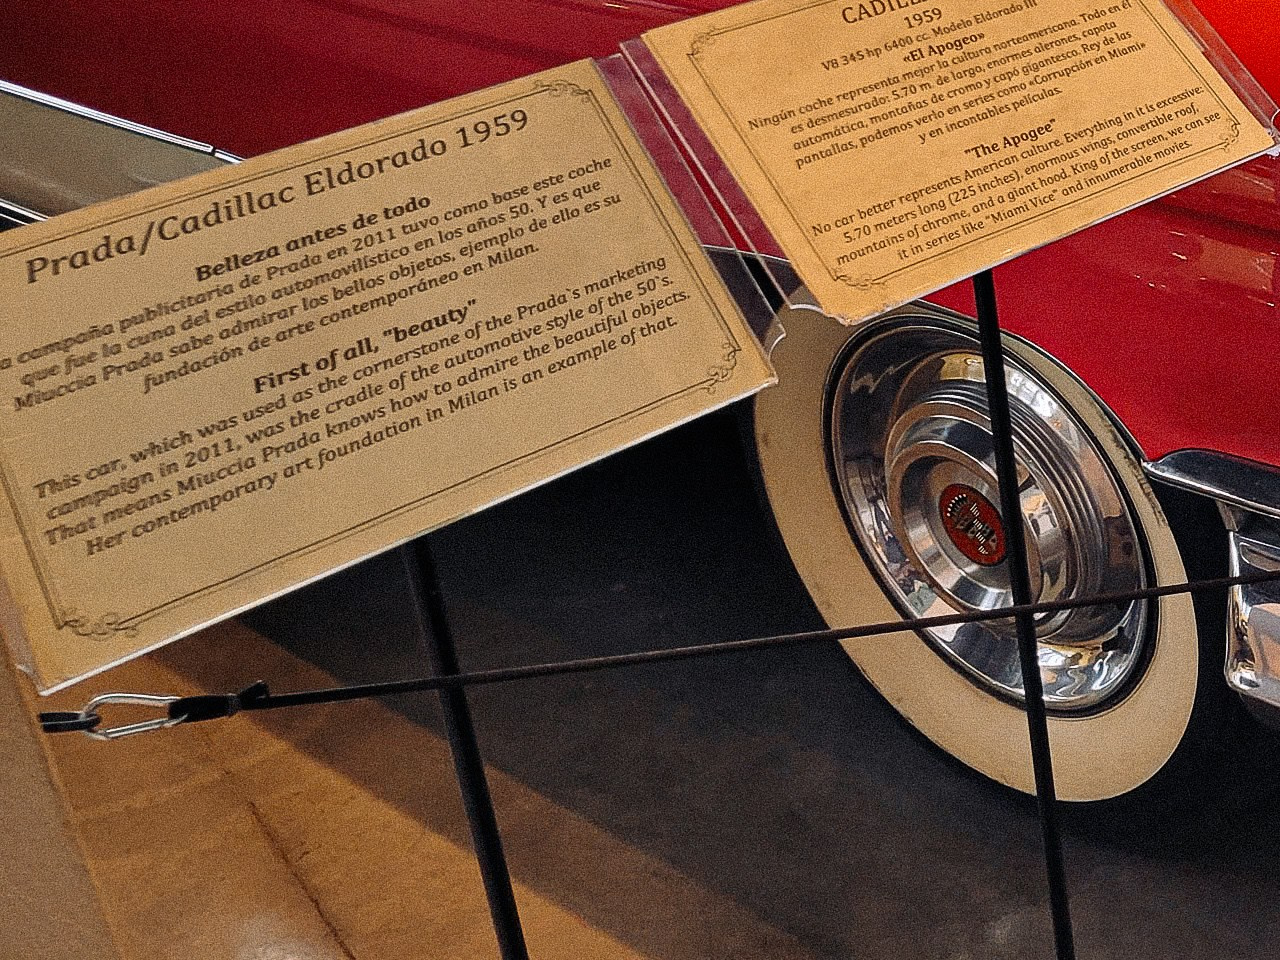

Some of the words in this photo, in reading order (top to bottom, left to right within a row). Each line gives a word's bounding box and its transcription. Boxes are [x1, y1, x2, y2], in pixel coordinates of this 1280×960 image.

[747, 109, 796, 130] Ningún
[797, 96, 834, 114] coche
[835, 75, 901, 101] representa
[901, 63, 935, 80] mejor
[935, 59, 949, 69] la
[950, 46, 992, 64] cultura
[992, 18, 1080, 51] norteamericana.
[1077, 8, 1107, 22] Todo
[1107, 4, 1121, 13] en
[789, 123, 804, 134] es
[805, 95, 890, 128] desmesurado:
[891, 83, 917, 100] 5.70
[935, 74, 950, 85] de
[949, 65, 985, 80] largo,
[986, 48, 1033, 69] enormes
[1081, 21, 1117, 38] capota
[903, 7, 942, 29] 1959
[792, 120, 868, 150] automática,
[868, 99, 929, 124] montañas
[930, 92, 945, 103] de
[946, 81, 983, 98] cromo
[982, 78, 990, 89] y
[992, 66, 1019, 83] capó
[1080, 40, 1100, 53] Rey
[1102, 36, 1115, 46] de
[1113, 30, 1132, 41] las
[794, 140, 858, 169] pantallas,
[858, 120, 914, 147] podemos
[913, 109, 945, 126] verlo
[945, 104, 961, 114] en
[962, 92, 995, 110] series
[995, 82, 1027, 98] como
[1093, 54, 1108, 64] en
[917, 132, 926, 144] y
[928, 127, 944, 138] en
[943, 103, 1011, 132] incontables
[1010, 86, 1063, 112] películas.
[963, 142, 1000, 158] "The
[1002, 117, 1056, 148] Apogee"
[25, 185, 296, 284] Prada/Cadillac
[303, 138, 447, 196] Eldorado
[455, 109, 528, 149] 1959
[810, 222, 831, 237] No
[833, 213, 855, 228] car
[855, 198, 896, 219] better
[897, 175, 962, 204] represents
[963, 154, 1019, 181] American
[1062, 115, 1123, 143] Everything
[1121, 111, 1135, 121] in
[1134, 106, 1146, 116] it
[1144, 103, 1156, 112] is
[1155, 86, 1204, 109] excessive:
[835, 232, 905, 265] mountains
[906, 223, 919, 238] of
[920, 209, 970, 232] chrome,
[971, 195, 995, 213] and
[996, 194, 1005, 204] a
[1006, 181, 1039, 200] giant
[1036, 167, 1071, 187] hood.
[1069, 159, 1098, 175] King
[1098, 150, 1111, 164] of
[1110, 147, 1130, 159] the
[1129, 133, 1168, 152] screen,
[1166, 126, 1184, 137] we
[1184, 118, 1204, 131] can
[1203, 111, 1221, 124] see
[842, 224, 871, 243] 5.70
[872, 209, 917, 232] meters
[916, 199, 946, 215] long
[947, 184, 976, 206] (225
[976, 169, 1024, 192] inches),
[1023, 148, 1080, 175] enormous
[1079, 136, 1116, 153] wings,
[1115, 112, 1174, 140] convertible
[1173, 101, 1199, 118] roof,
[896, 248, 909, 260] it
[909, 244, 924, 255] in
[924, 229, 961, 249] series
[960, 220, 985, 235] like
[1061, 179, 1084, 196] and
[1083, 154, 1153, 187] innumerable
[1152, 140, 1192, 160] movies.
[193, 245, 281, 282] Belleza
[284, 223, 347, 252] antes
[351, 212, 378, 230] de
[381, 196, 431, 220] todo
[32, 473, 81, 498] This
[84, 458, 127, 480] car,
[128, 430, 193, 463] which
[195, 415, 238, 438] was
[241, 393, 287, 422] used
[291, 387, 313, 403] as
[316, 374, 348, 393] the
[352, 333, 460, 380] cornerstone
[463, 320, 482, 340] of
[484, 313, 513, 331] the
[583, 257, 666, 295] marketing
[43, 516, 97, 545] That
[102, 488, 172, 524] means
[175, 456, 256, 495] Miuccia
[260, 431, 321, 463] Prada
[324, 405, 386, 438] knows
[388, 388, 428, 412] how
[432, 381, 452, 395] to
[456, 355, 519, 386] admire
[522, 343, 551, 361] the
[552, 309, 628, 349] beautiful
[631, 290, 690, 319] objects.
[45, 471, 154, 520] campaign
[158, 461, 179, 477] in
[184, 437, 242, 468] 2011,
[244, 421, 285, 444] was
[288, 408, 320, 428] the
[324, 383, 384, 414] cradle
[387, 370, 408, 391] of
[410, 362, 439, 381] the
[443, 324, 543, 369] automotive
[545, 308, 584, 331] style
[587, 296, 604, 315] of
[606, 289, 633, 307] the
[252, 361, 311, 394] First
[313, 347, 339, 371] of
[342, 336, 379, 361] all,
[85, 530, 127, 556] Her
[131, 471, 278, 537] contemporary
[282, 457, 314, 478] art
[317, 416, 422, 469] foundation
[425, 407, 444, 422] in
[447, 385, 500, 413] Milan
[502, 378, 518, 392] is
[521, 368, 544, 384] an
[547, 339, 617, 374] example
[619, 326, 636, 346] of
[638, 315, 678, 337] that.
